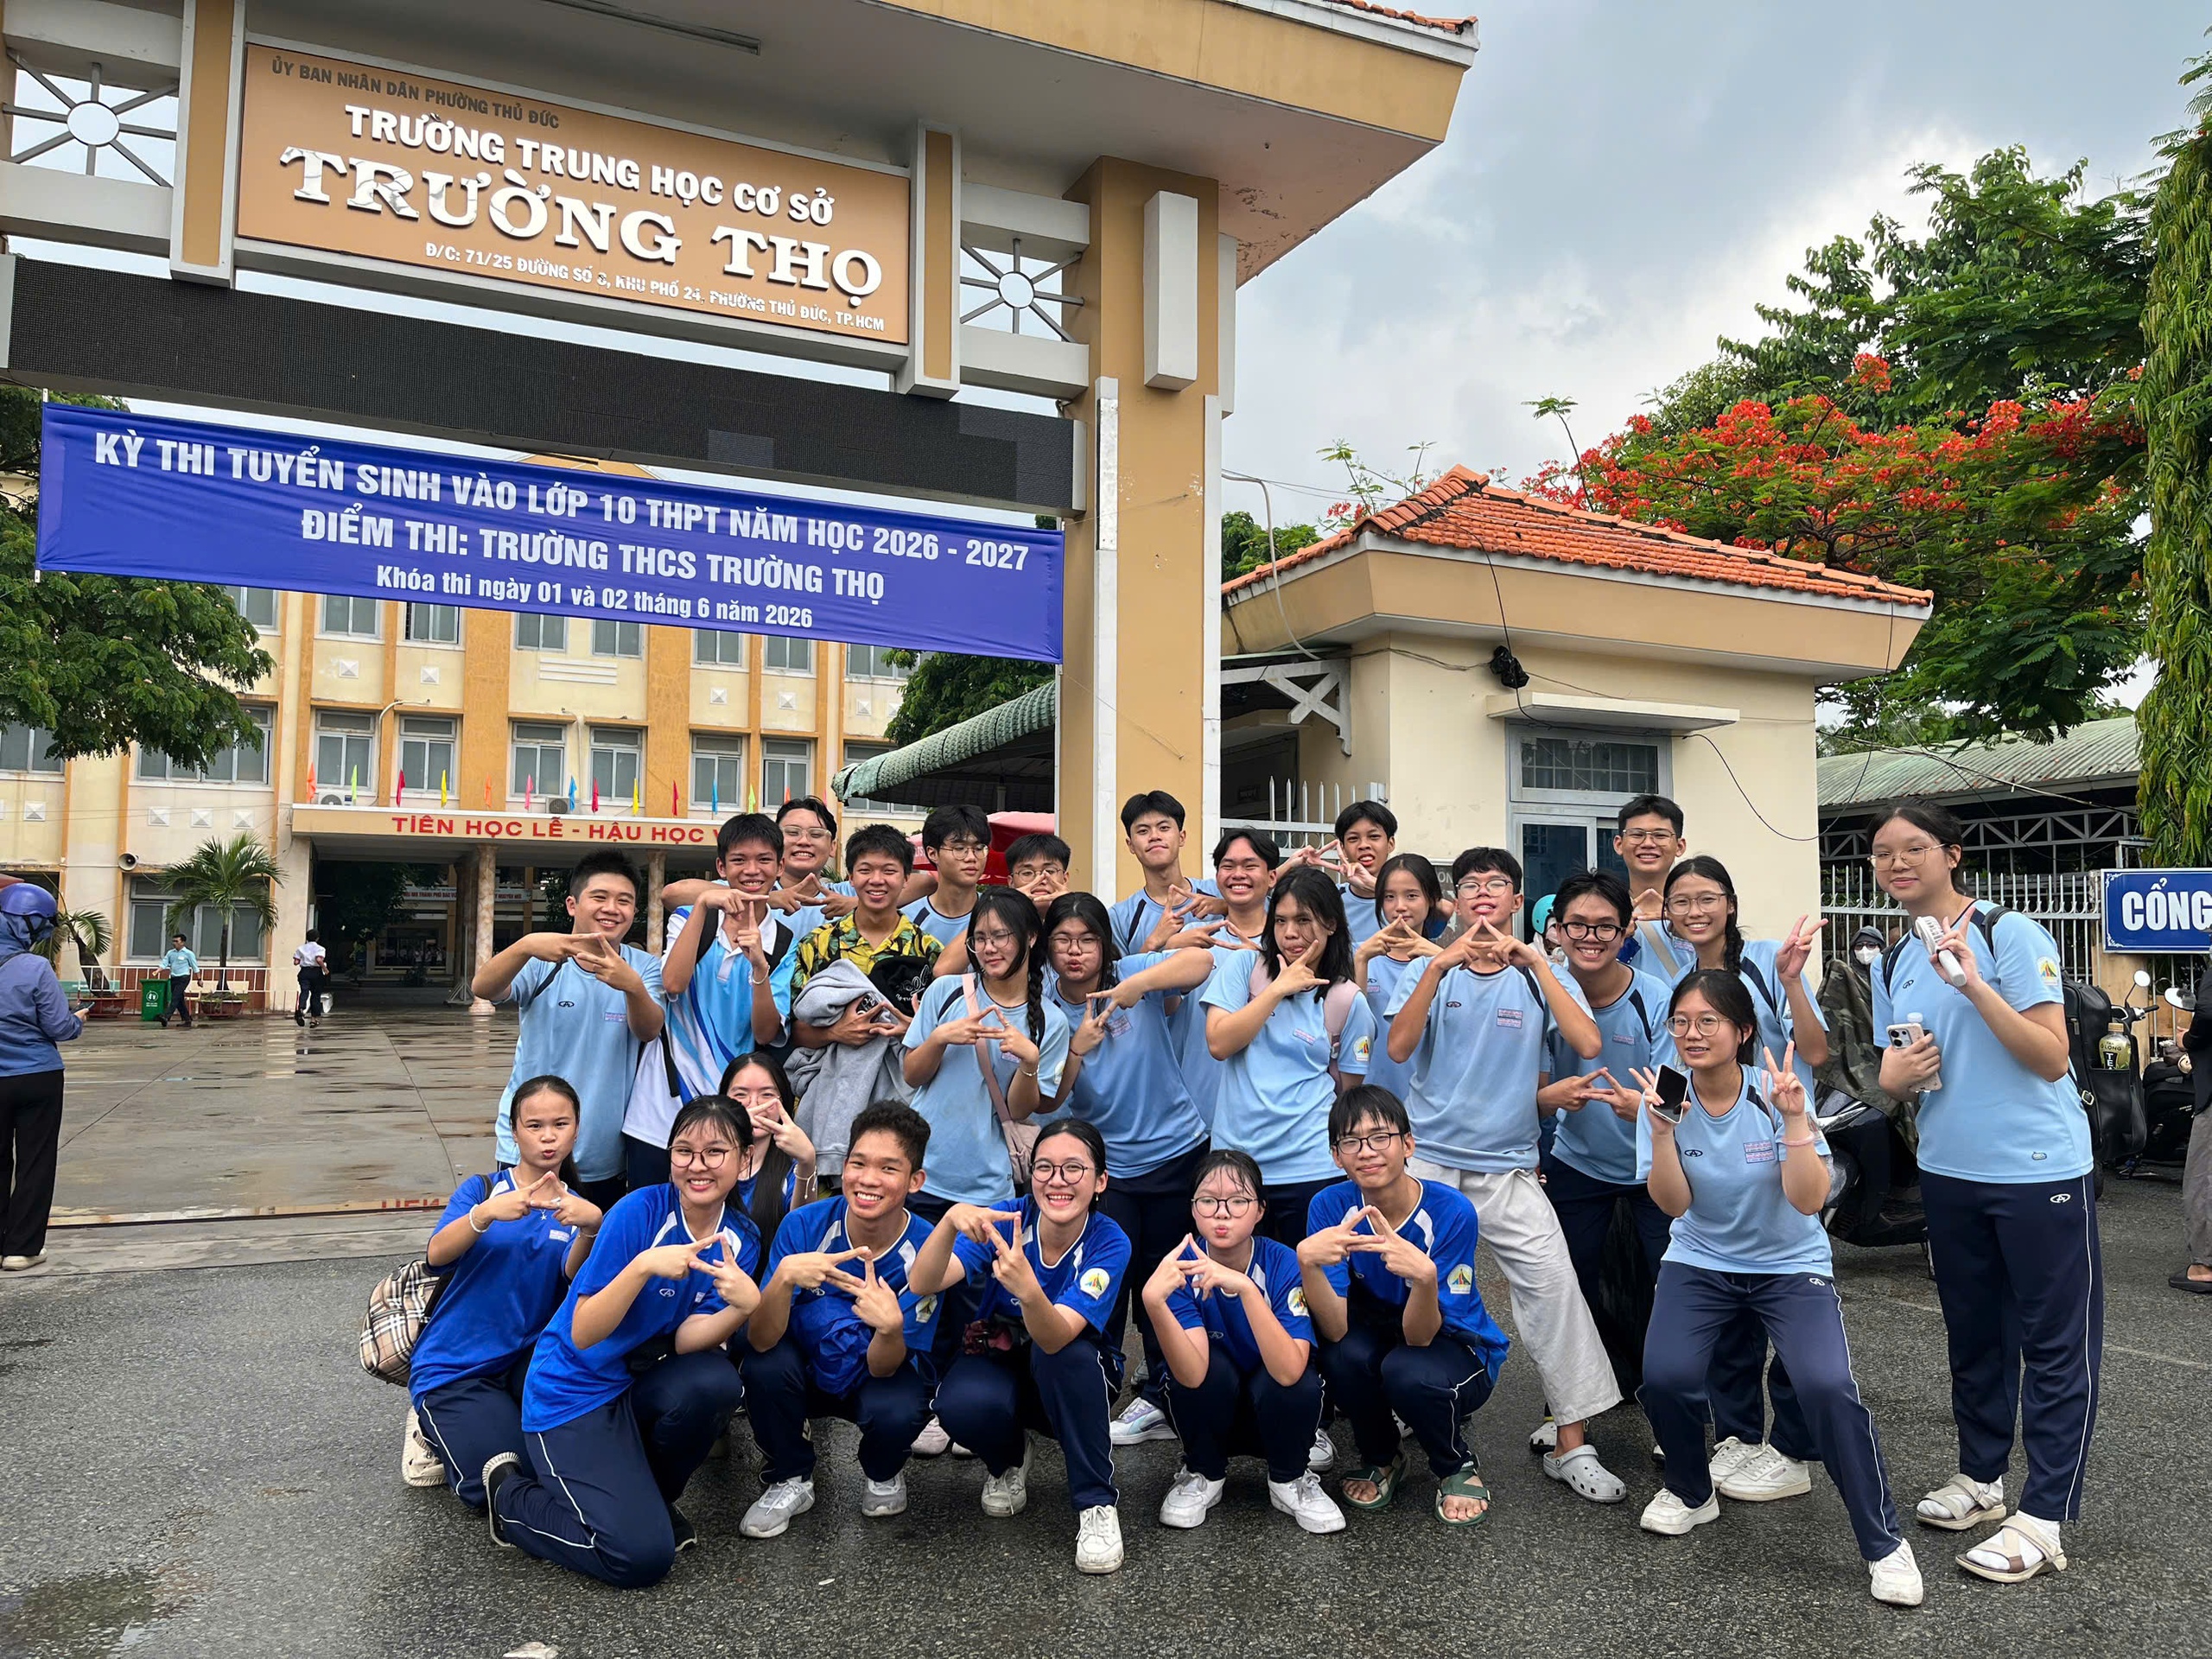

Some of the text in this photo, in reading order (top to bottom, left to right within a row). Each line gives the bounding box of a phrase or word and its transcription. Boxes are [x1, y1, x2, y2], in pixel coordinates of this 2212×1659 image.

[272, 55, 560, 129] ỦY BAN NHÂN DÂN PHƯỜNG THỦ ĐỨC
[345, 105, 836, 226] TRƯỜNG TRUNG HỌC CƠ SỞ
[280, 146, 883, 308] TRƯỜNG THỌ
[425, 242, 461, 262] Đ/C:
[465, 249, 513, 270] 71/25
[572, 265, 594, 283] SỐ
[615, 275, 646, 293] KHU
[650, 279, 680, 298] PHỐ
[683, 286, 705, 304] 24,
[768, 299, 797, 317] THỦ
[800, 304, 832, 325] ĐỨC,
[835, 311, 885, 332] TP.HCM
[95, 429, 1029, 571] KỲ THI TUYỂN SINH VÀO LỚP 10 THPT NĂM HỌC 2026 - 2027
[302, 503, 885, 605] ĐIỂM THI: TRƯỜNG THCS TRƯỜNG THỌ
[377, 565, 813, 628] Khóa thi ngày 01 và 02 tháng 6 năm 2026
[466, 819, 523, 838] HỌC
[532, 817, 563, 837] LỄ
[588, 821, 641, 842] HẬU
[652, 826, 704, 845] HỌC
[2122, 877, 2212, 931] CỔNG
